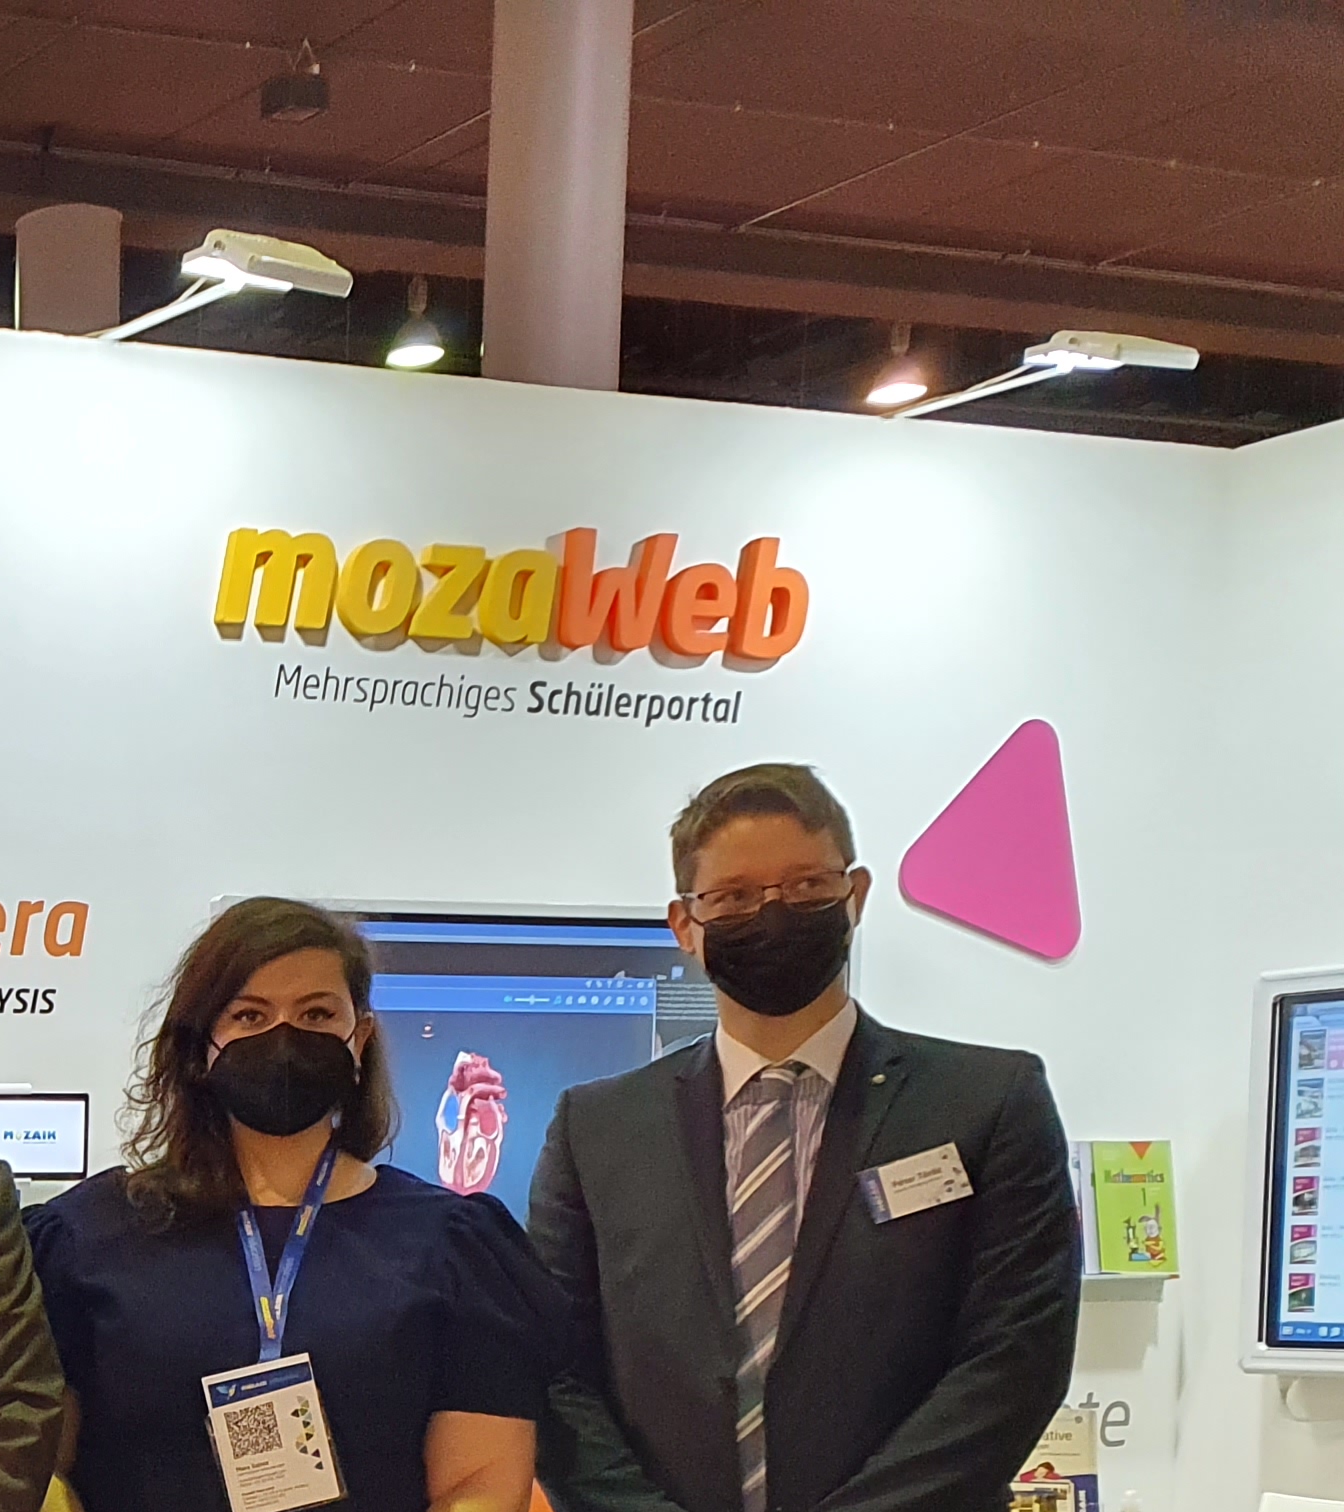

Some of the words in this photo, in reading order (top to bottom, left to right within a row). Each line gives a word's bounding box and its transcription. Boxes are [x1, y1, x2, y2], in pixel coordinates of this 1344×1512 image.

[214, 528, 810, 670] mozaWeb
[274, 663, 517, 717] Mehrsprachiges
[526, 680, 742, 727] Schülerportal
